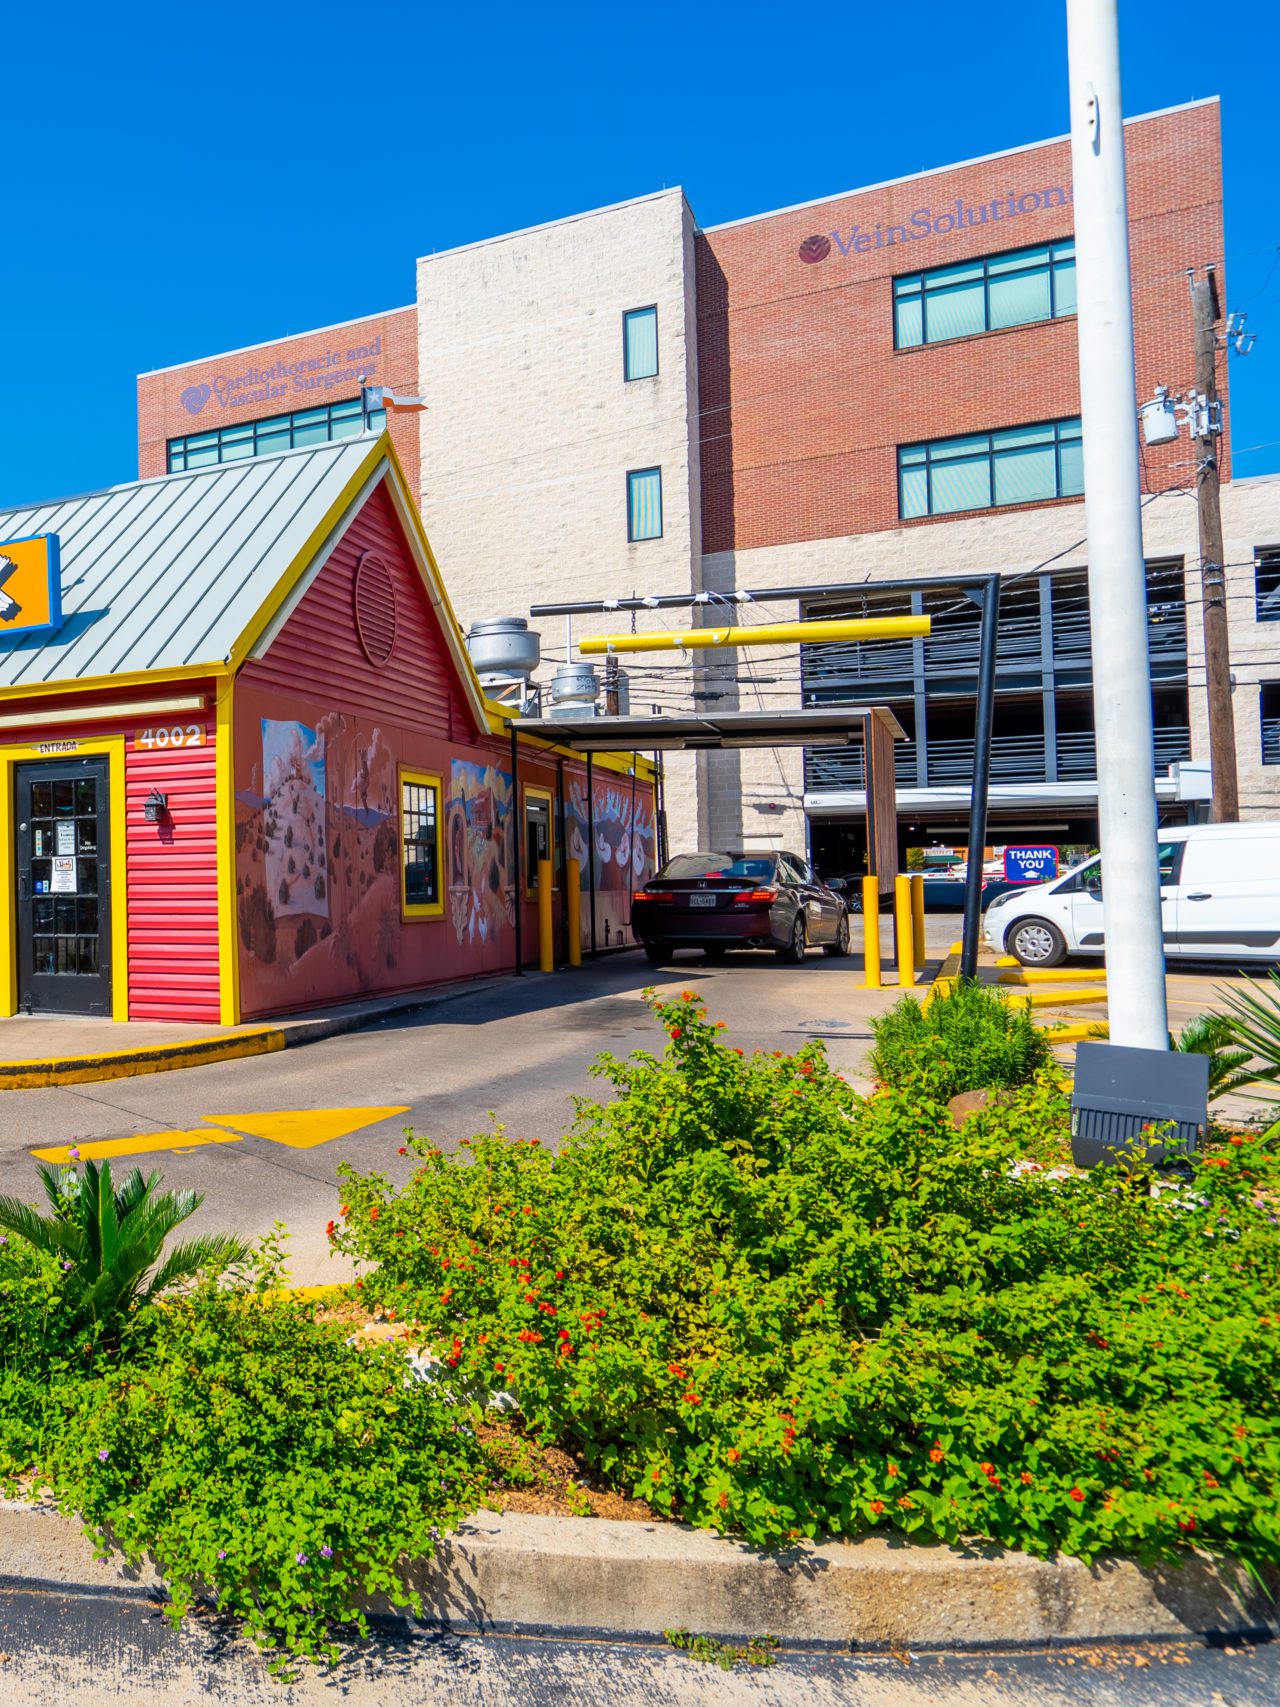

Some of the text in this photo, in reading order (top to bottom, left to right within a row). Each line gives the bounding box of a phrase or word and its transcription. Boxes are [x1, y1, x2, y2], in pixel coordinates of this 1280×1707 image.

[830, 184, 1074, 257] VeinSolution
[211, 335, 381, 394] Cardiothoracic and
[216, 362, 377, 409] Vascular Surgeons
[39, 740, 78, 754] ENTRADA
[140, 724, 201, 749] 4002
[1008, 850, 1052, 860] THANK
[1018, 860, 1045, 869] YOU
